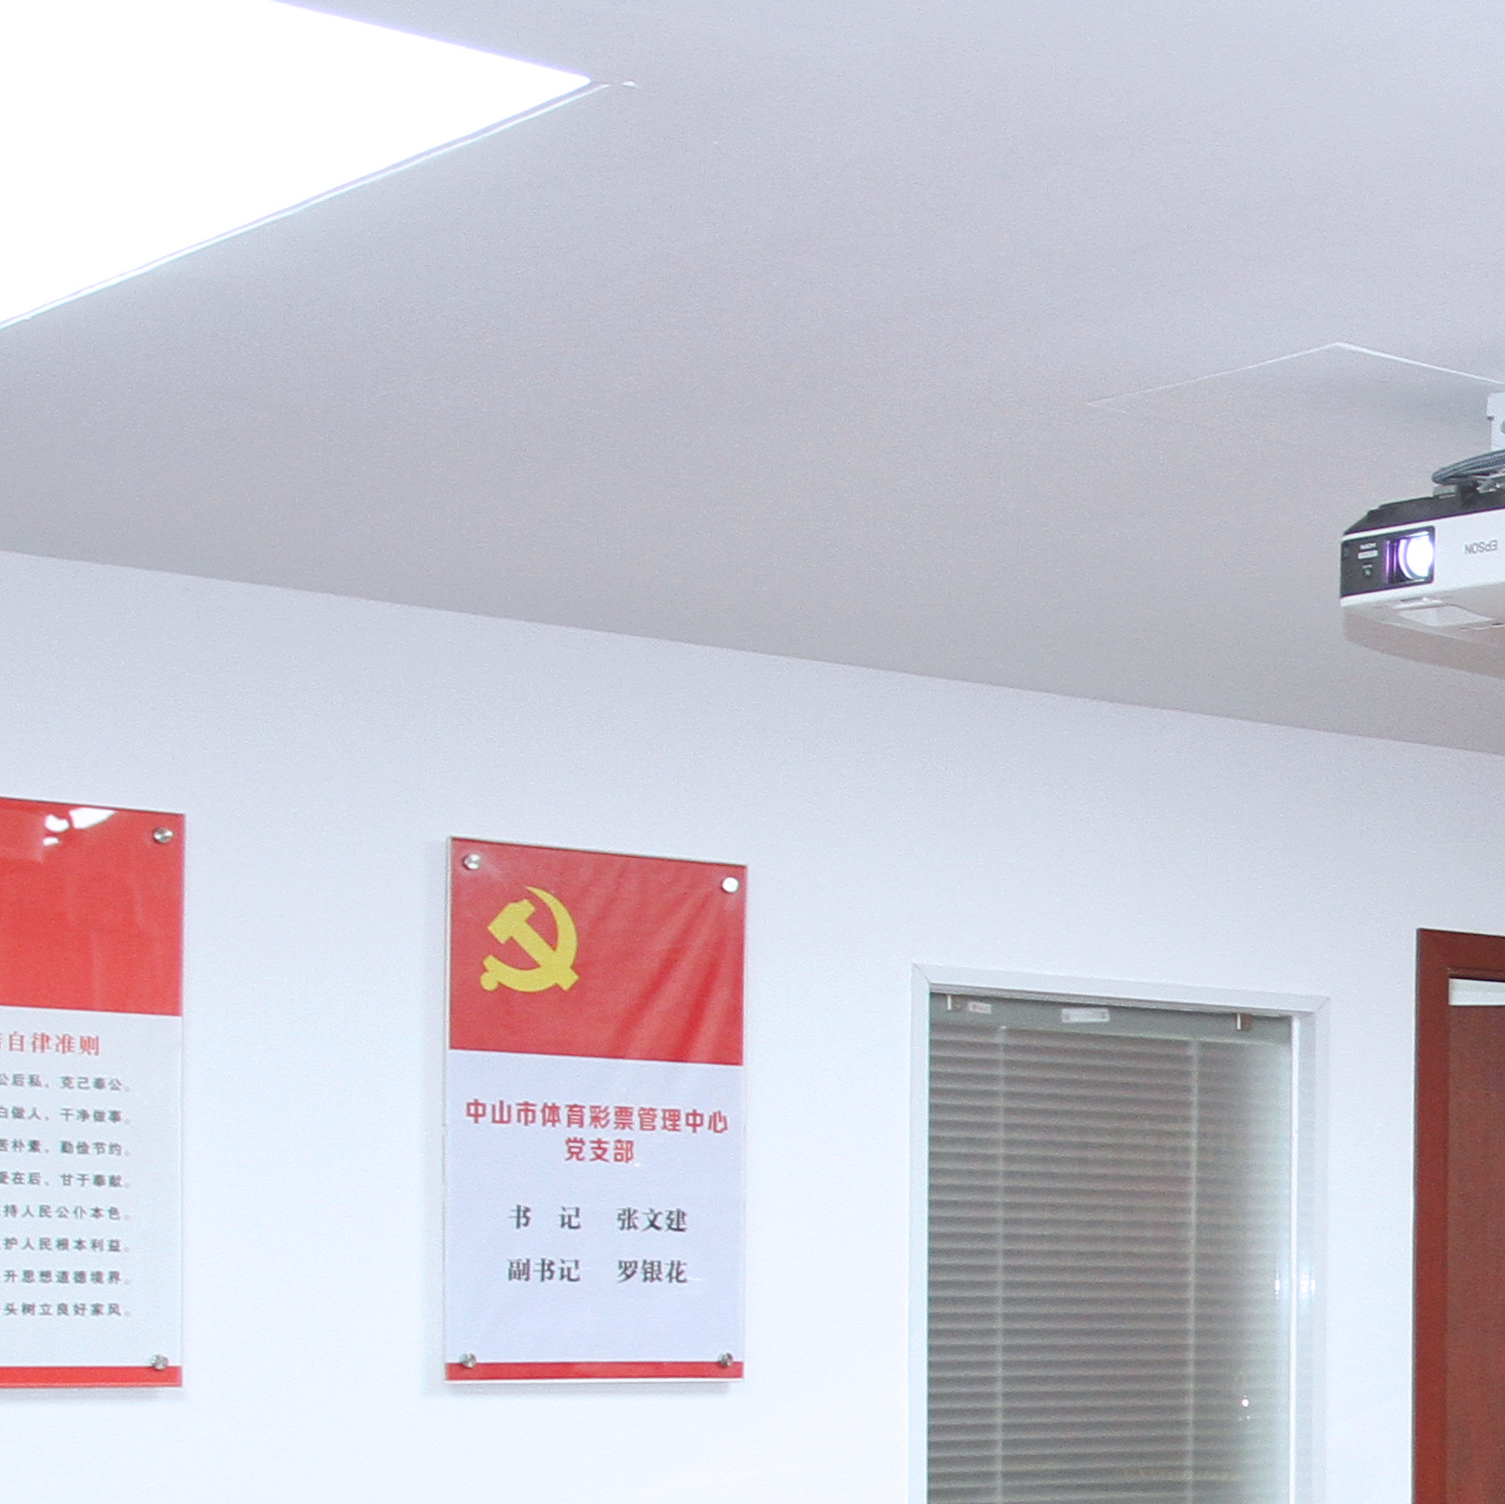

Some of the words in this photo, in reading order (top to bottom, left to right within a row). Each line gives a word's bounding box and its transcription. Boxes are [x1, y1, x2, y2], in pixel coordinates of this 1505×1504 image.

[1464, 540, 1498, 555] EPSON
[0, 1031, 100, 1056] 自律准则
[466, 1098, 729, 1134] 中山市体育彩票管理中心
[565, 1137, 635, 1163] 党支部
[616, 1207, 688, 1232] 张文建
[508, 1257, 581, 1283] 副书记
[617, 1259, 688, 1283] 罗银花
